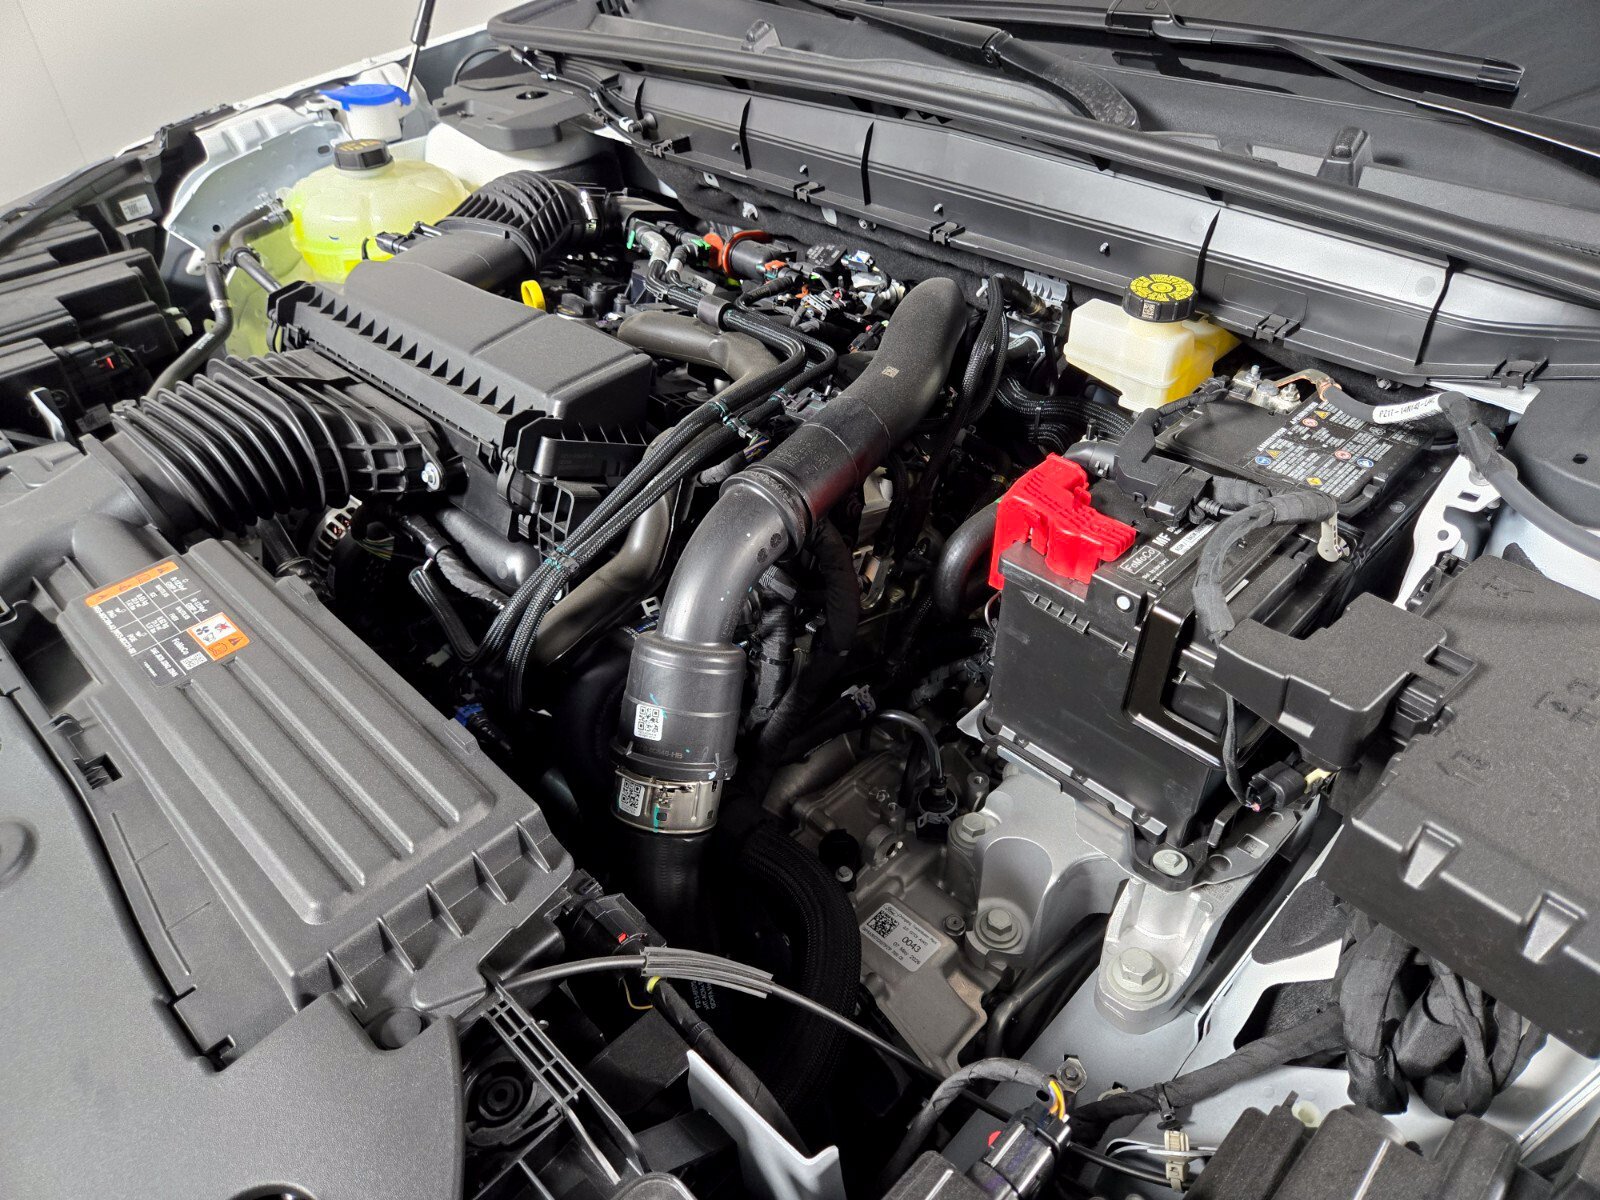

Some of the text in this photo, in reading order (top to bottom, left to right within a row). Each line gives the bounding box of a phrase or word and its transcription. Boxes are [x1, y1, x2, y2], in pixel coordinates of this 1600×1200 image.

[1152, 532, 1171, 547] MF
[1125, 549, 1156, 572] FoMoCo
[902, 936, 921, 953] 0043
